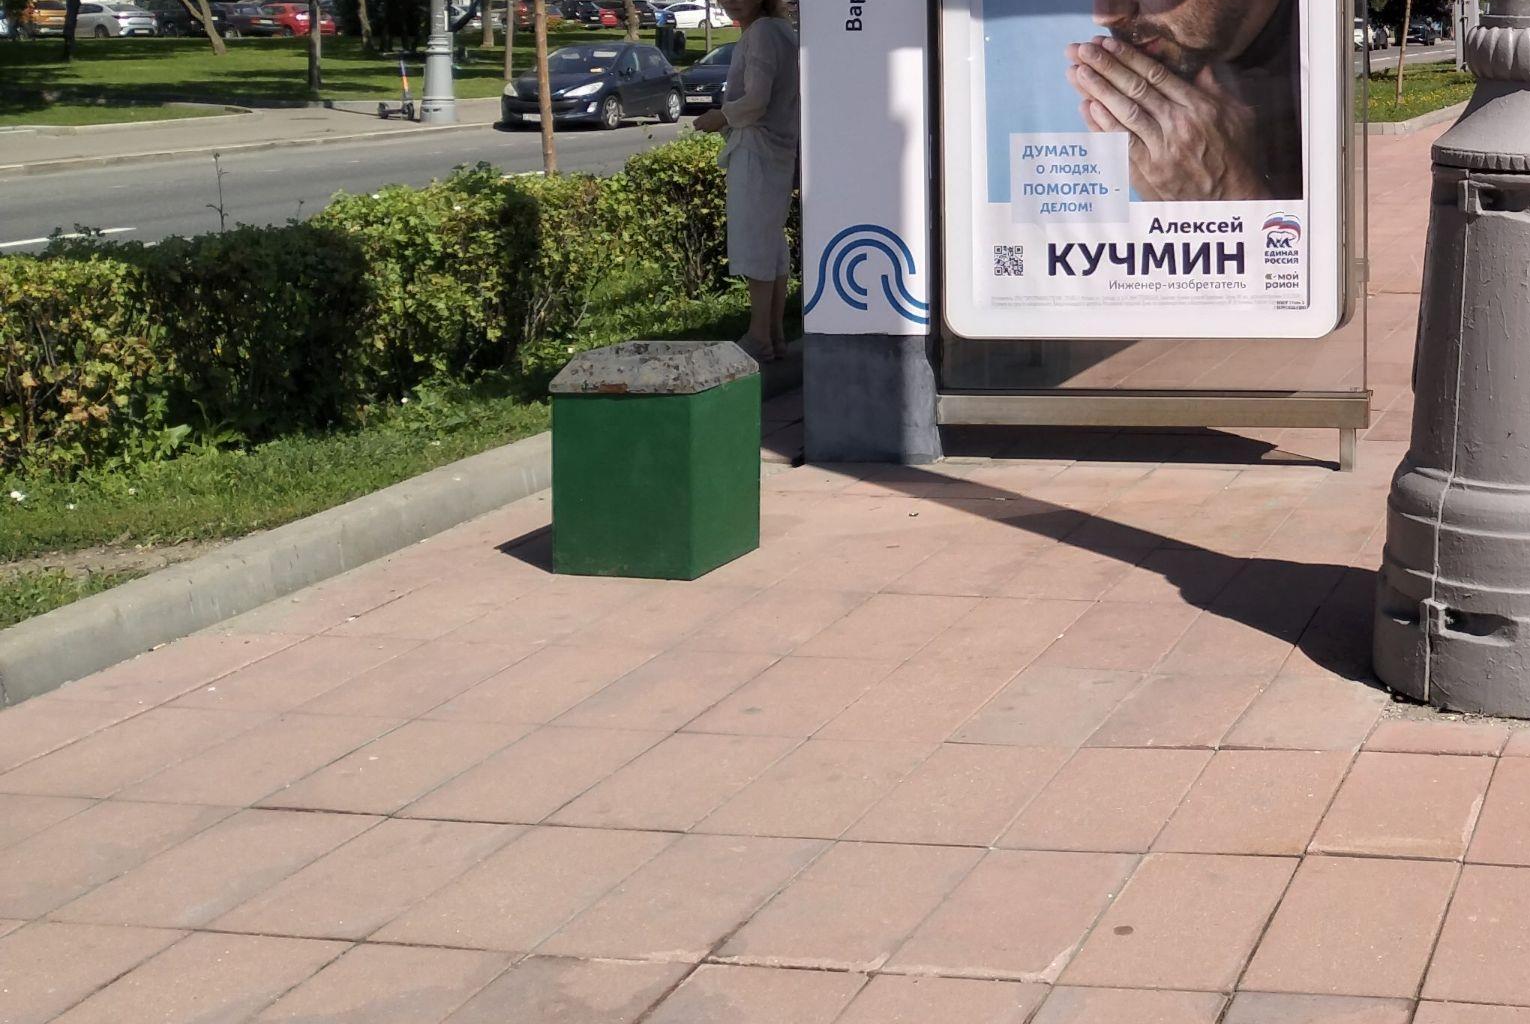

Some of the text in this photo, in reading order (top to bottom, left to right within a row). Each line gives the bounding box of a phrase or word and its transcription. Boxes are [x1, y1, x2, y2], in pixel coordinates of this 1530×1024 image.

[1022, 144, 1088, 159] ДУМАТЬ
[1050, 163, 1101, 176] ЛЮДЯХ,
[1023, 182, 1109, 196] ПОМОГАТЬ
[1040, 201, 1093, 215] ДЕЛОМ!
[1148, 216, 1244, 234] Алексей
[1047, 241, 1245, 277] КУЧМИН
[1264, 249, 1299, 257] ЕДИНАЯ
[1264, 257, 1299, 265] РОССИЯ
[1108, 279, 1247, 292] Инженер-изобретатель
